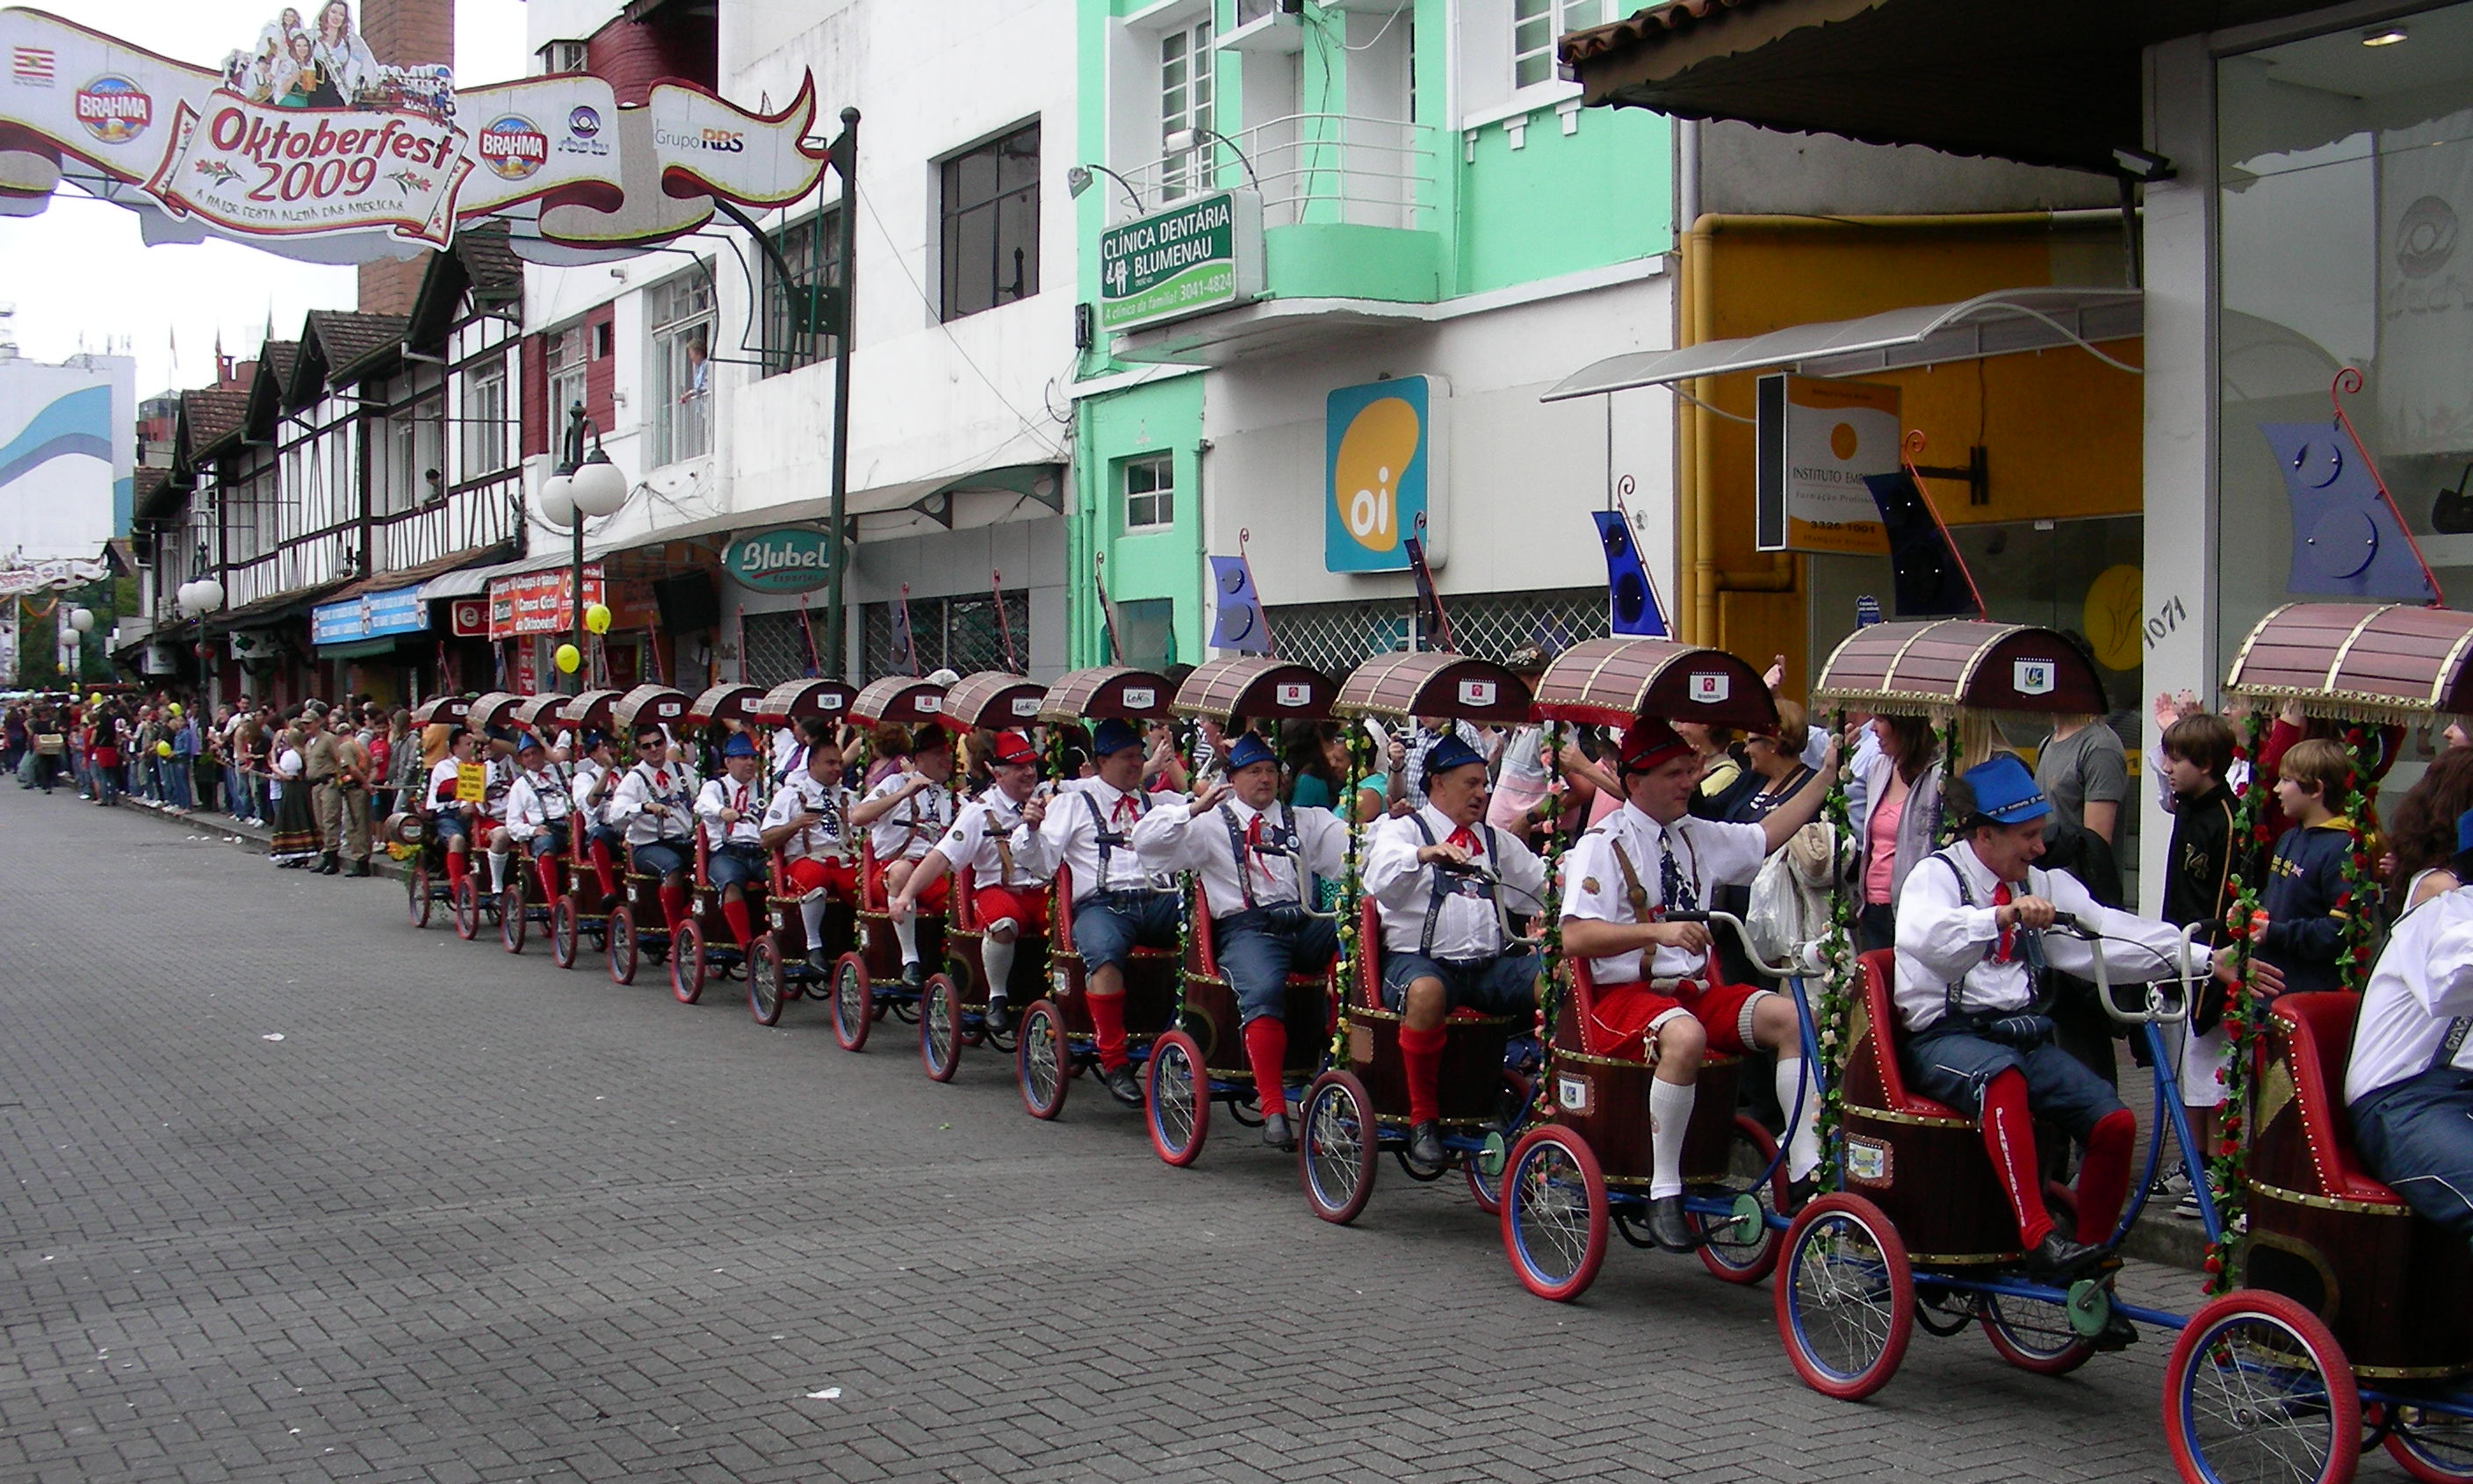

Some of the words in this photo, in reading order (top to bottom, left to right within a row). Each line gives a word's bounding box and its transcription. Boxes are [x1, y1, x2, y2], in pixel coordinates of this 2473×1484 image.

[80, 94, 148, 119] BRAHMA
[212, 107, 454, 169] Oktoberfest
[483, 133, 544, 158] BRAHMA
[655, 128, 700, 150] Grupo
[703, 128, 744, 153] RBS
[248, 157, 378, 202] 2009
[194, 189, 204, 199] A
[242, 205, 277, 220] FESTA
[323, 202, 344, 217] DAS
[1104, 227, 1156, 260] CLÍNICA
[1159, 204, 1229, 243] DENTÁRIA
[1135, 236, 1212, 277] BLUMENAU
[1104, 308, 1111, 321] A
[1179, 272, 1231, 301] 3041-4824
[1793, 466, 1842, 483] INSTITUTO
[1351, 466, 1388, 537] oi
[742, 542, 830, 570] Blubel
[2143, 594, 2187, 650] 1071
